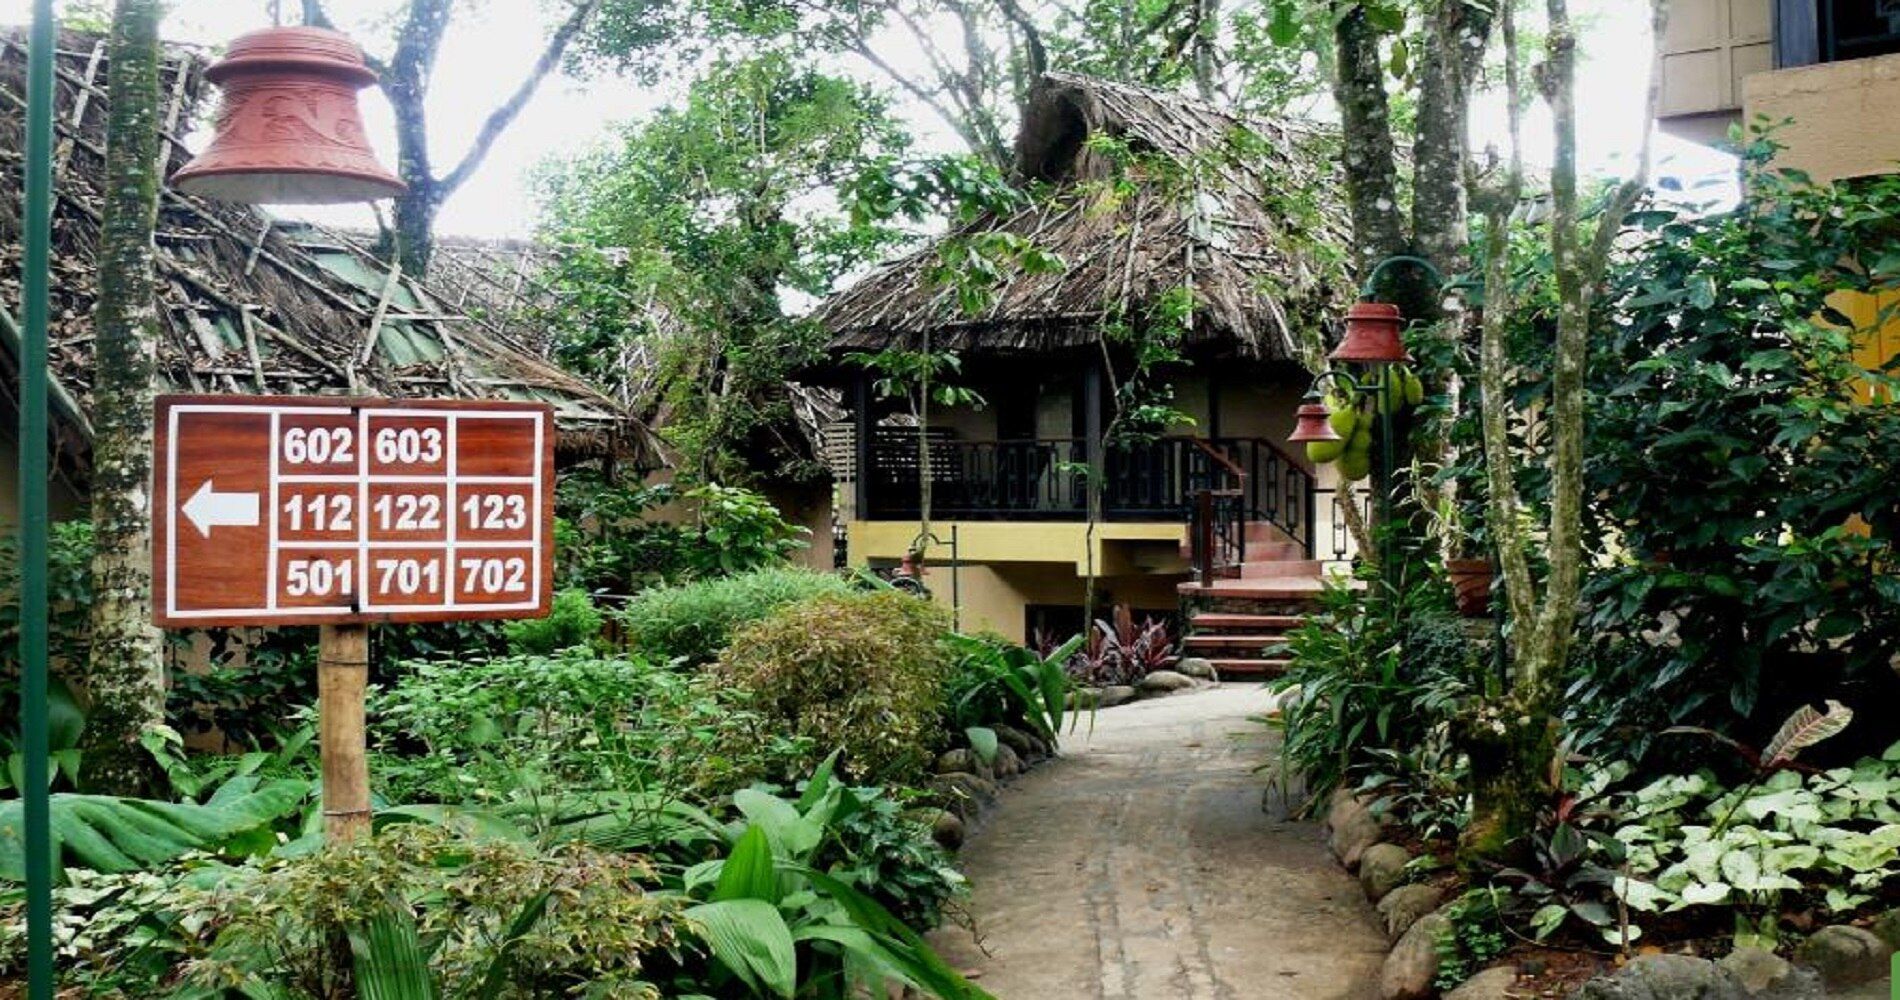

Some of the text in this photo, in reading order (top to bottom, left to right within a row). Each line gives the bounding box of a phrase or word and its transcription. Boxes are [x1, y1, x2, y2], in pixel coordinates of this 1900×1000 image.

[284, 427, 442, 464] 602 603
[284, 494, 527, 531] 112 122 123
[286, 557, 526, 596] 501 701 702
